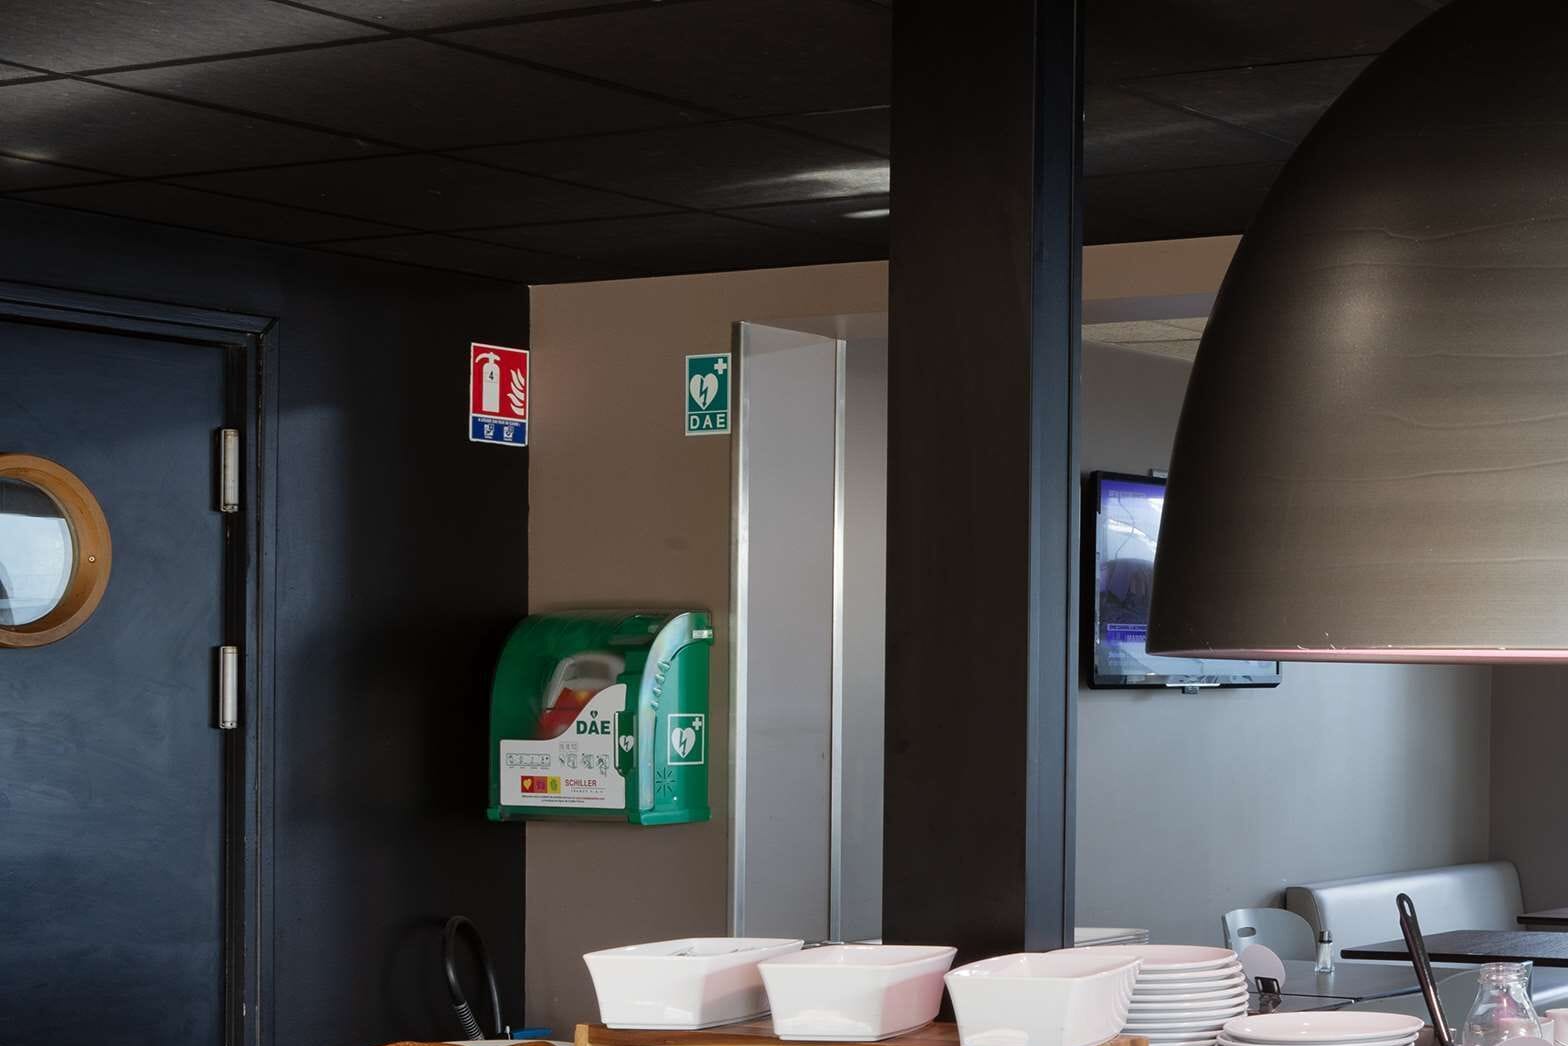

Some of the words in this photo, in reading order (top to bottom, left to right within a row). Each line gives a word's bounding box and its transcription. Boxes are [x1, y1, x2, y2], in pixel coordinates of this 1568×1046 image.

[689, 413, 726, 430] DAE
[576, 720, 611, 735] DAE
[565, 779, 598, 787] SCHILLER
